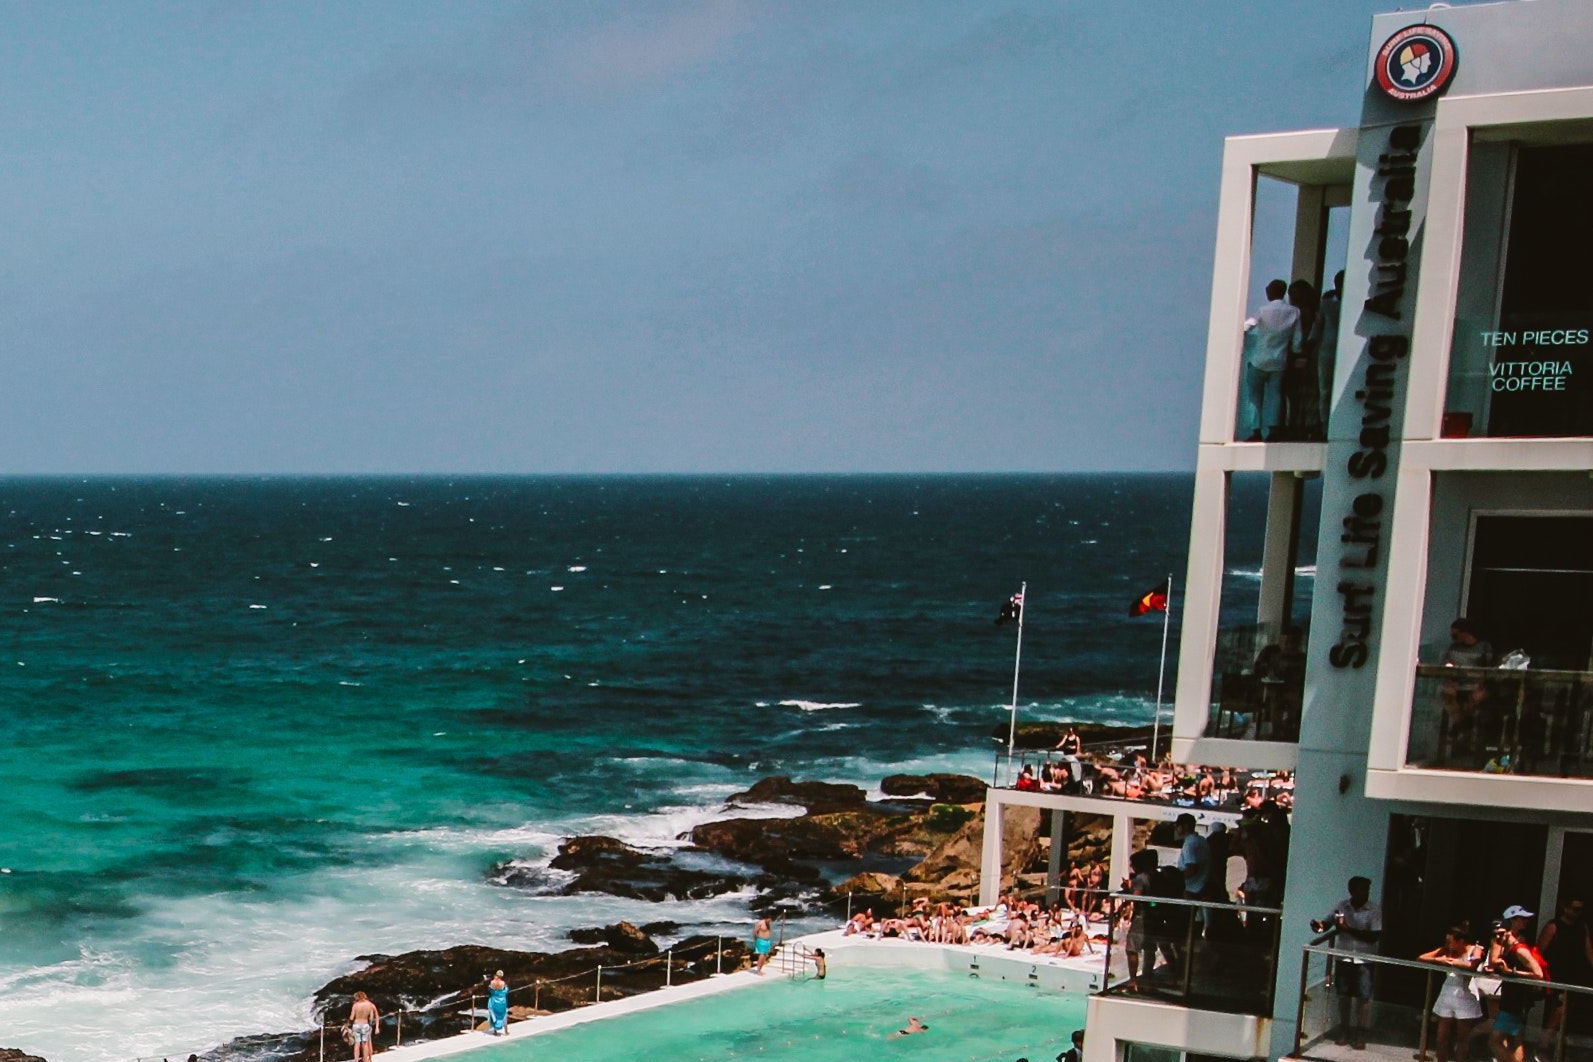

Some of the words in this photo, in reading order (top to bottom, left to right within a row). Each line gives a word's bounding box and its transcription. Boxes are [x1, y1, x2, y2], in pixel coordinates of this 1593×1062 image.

[1403, 27, 1423, 37] LIFE
[1387, 84, 1437, 100] AUSTRALIA
[1364, 125, 1422, 320] Australia
[1480, 331, 1517, 347] TEN
[1522, 329, 1589, 345] PIECES
[1488, 361, 1573, 376] VITTORIA
[1492, 376, 1567, 392] COFFEE
[1347, 334, 1409, 479] Saving
[1339, 493, 1383, 568] Life
[1329, 581, 1376, 669] Surf
[1031, 965, 1037, 974] 2
[1092, 974, 1098, 983] 3
